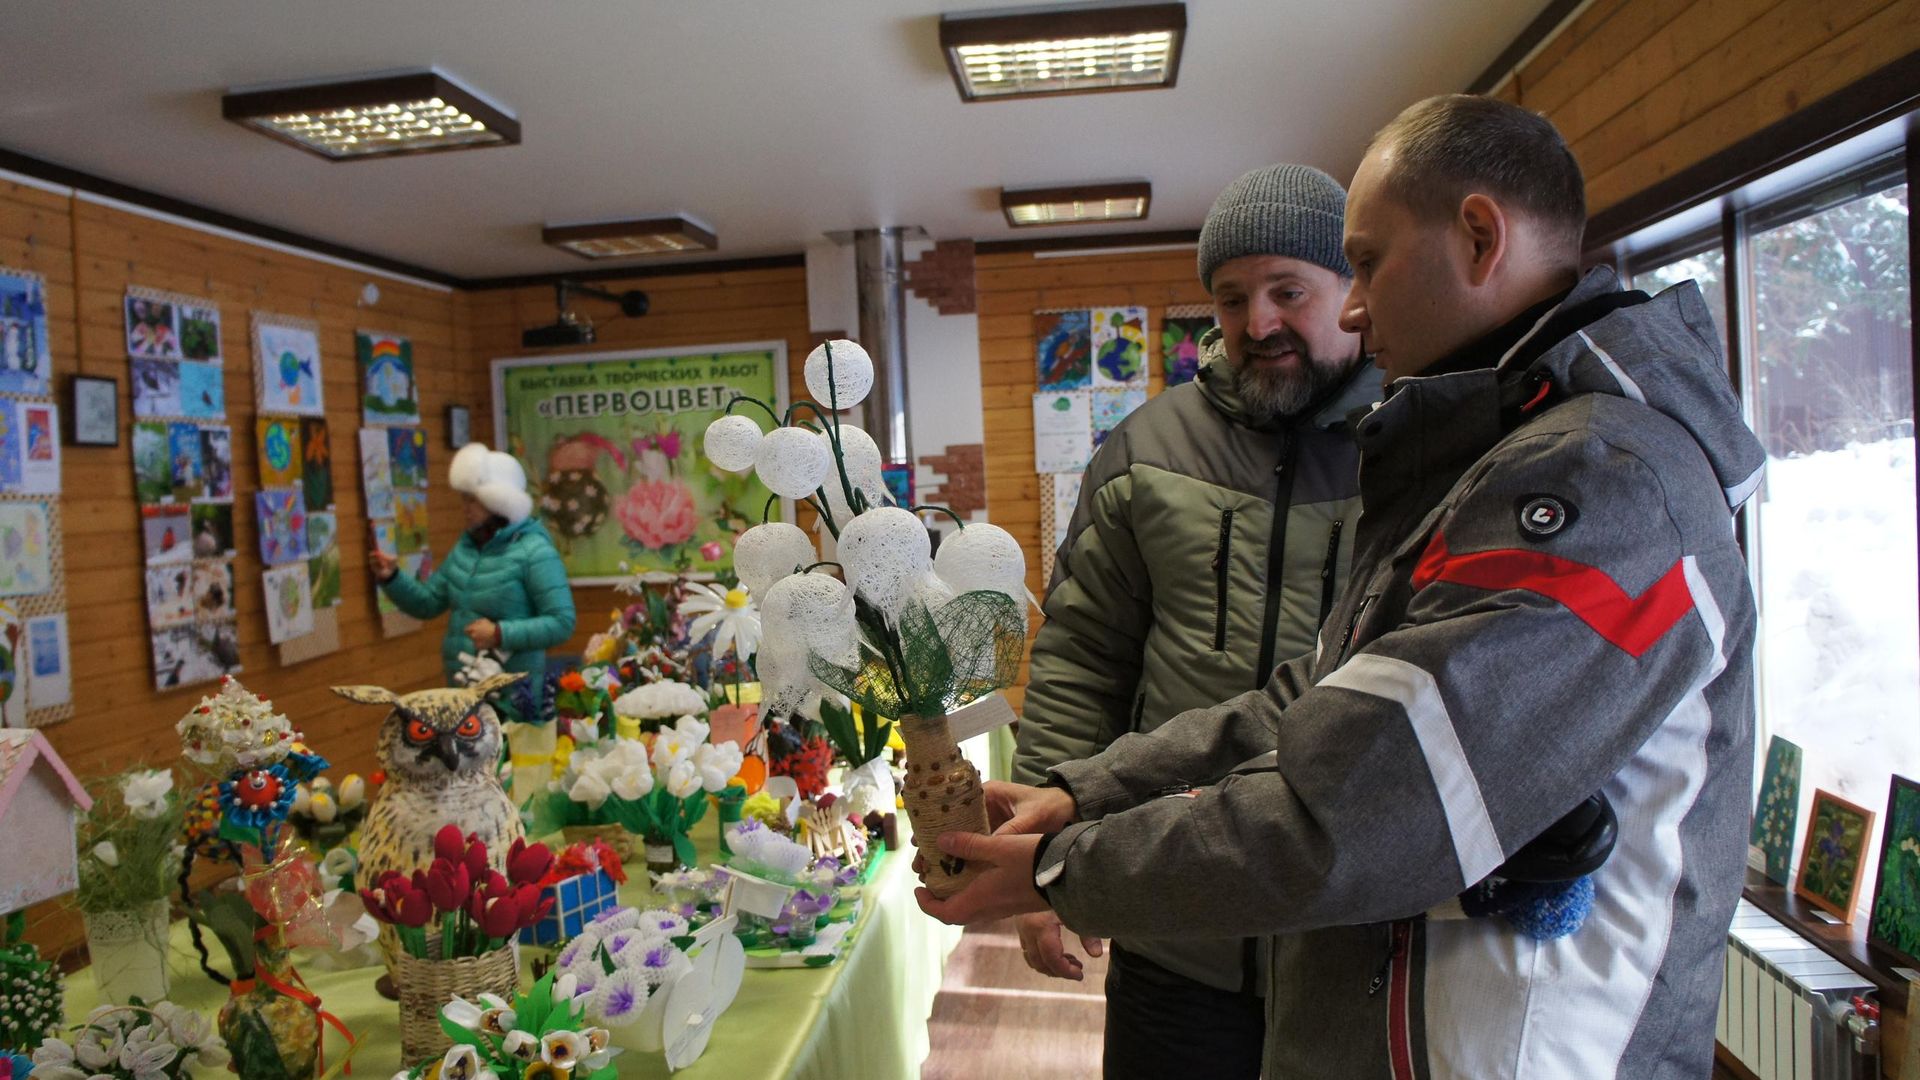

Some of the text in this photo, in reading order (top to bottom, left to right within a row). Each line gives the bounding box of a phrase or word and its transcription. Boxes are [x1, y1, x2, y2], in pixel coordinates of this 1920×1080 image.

[519, 364, 759, 390] ВЫСТАВКА ТВОРЧЕСКИХ РАБОТ
[538, 386, 743, 416] «ПЕРВОЦВЕТ»
